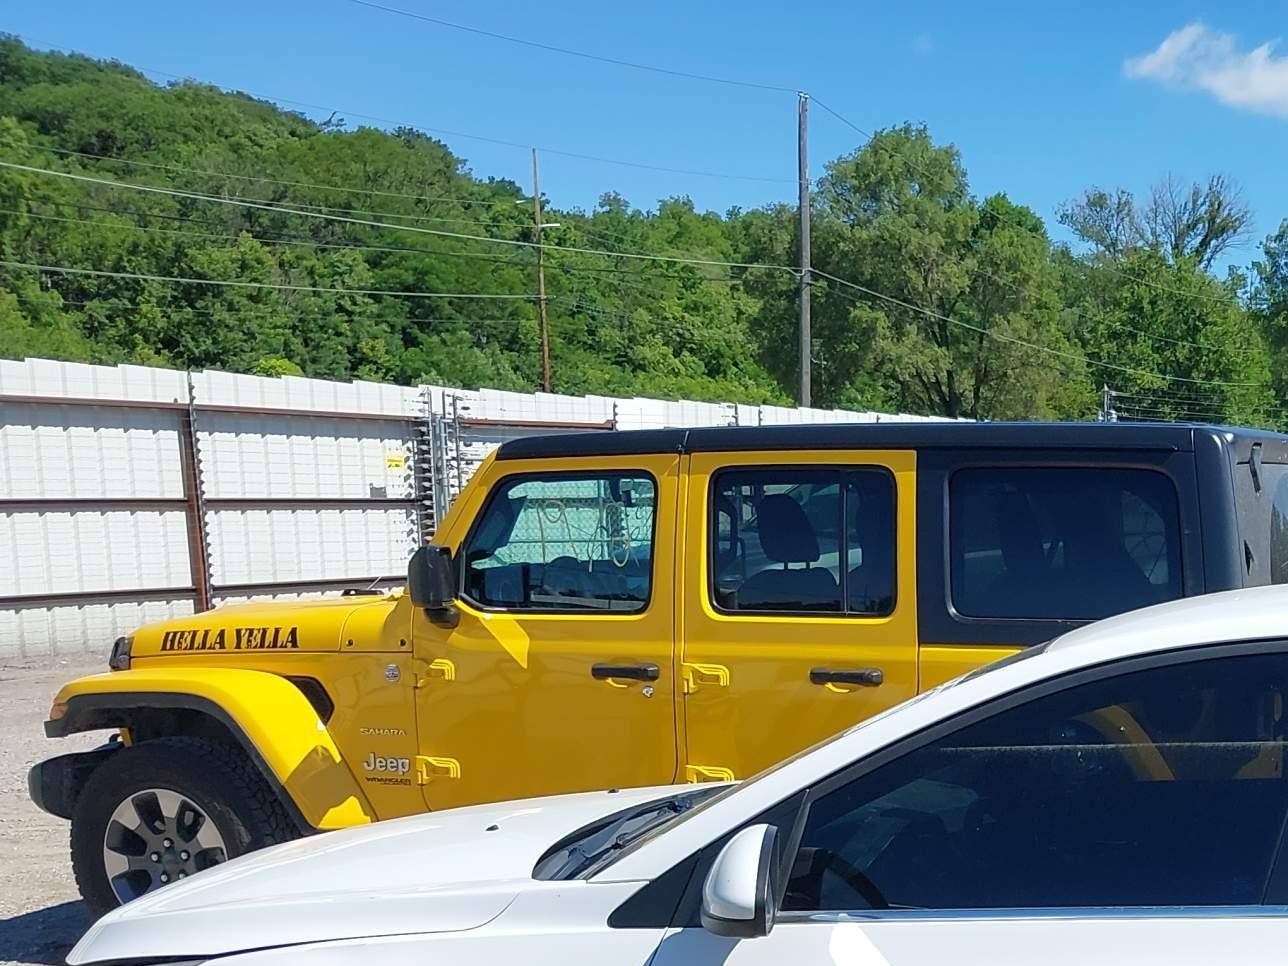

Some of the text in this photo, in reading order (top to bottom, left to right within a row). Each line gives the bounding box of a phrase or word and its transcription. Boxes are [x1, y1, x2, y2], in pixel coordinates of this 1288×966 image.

[160, 626, 299, 651] HELLA YELLA
[359, 728, 408, 736] SAHARA
[363, 751, 410, 775] Jeep
